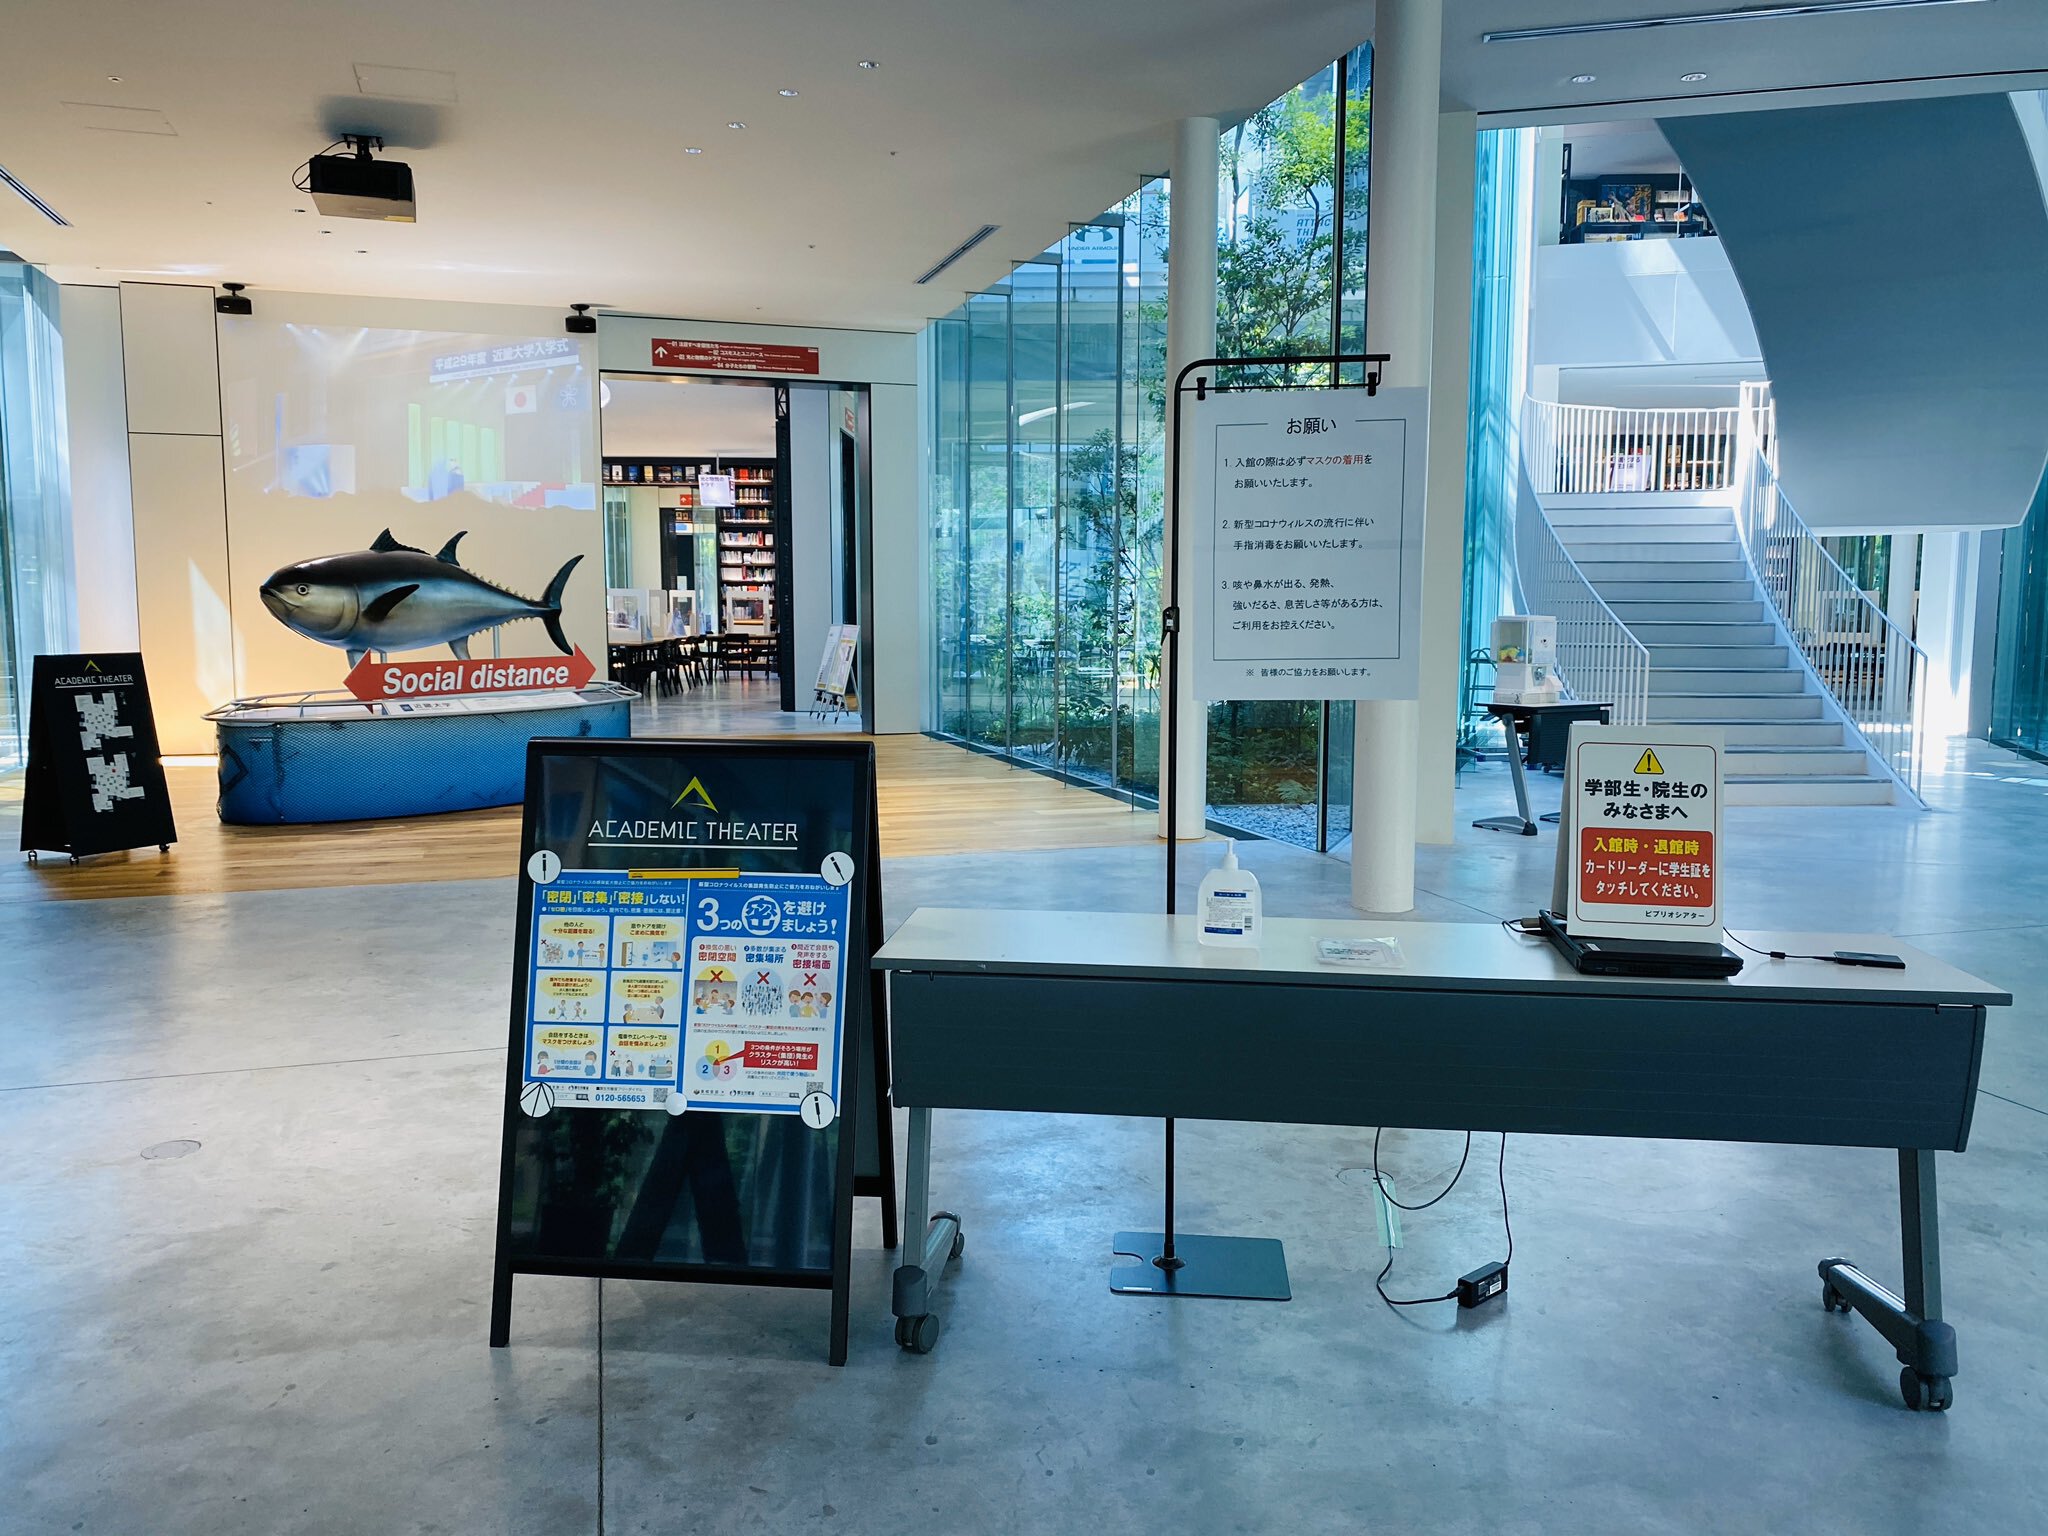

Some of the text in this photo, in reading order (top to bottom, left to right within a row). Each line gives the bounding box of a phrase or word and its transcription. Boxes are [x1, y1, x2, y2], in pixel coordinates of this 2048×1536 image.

[1286, 417, 1336, 434] お願い
[1235, 454, 1372, 468] 入館の際は必ずマスクの着用を
[1234, 478, 1313, 488] お願いいたします。
[1234, 517, 1374, 530] 新型コロナウィルスの流行に伴い
[1234, 538, 1364, 550] 手指消毒をお願いいたします。
[1232, 578, 1334, 590] 咳や鼻水が出る、発熱、
[1232, 598, 1384, 610] 強いだるさ、息苦しさ等がある方は、
[1232, 620, 1335, 630] ご利用をお控えください。
[1261, 668, 1371, 677] 皆様のご協力をお願いします。
[54, 674, 134, 685] ACADEMIC THEATER
[382, 664, 569, 694] Social distance
[1584, 778, 1708, 799] 学部生・院生の
[1604, 802, 1688, 820] みなさまへ
[588, 820, 798, 841] ACADEMIC THEATER
[1594, 837, 1700, 856] 入館時・退館時
[1586, 859, 1710, 878] カードリーダーに学生証を
[1596, 881, 1699, 899] タッチしてください。
[542, 890, 686, 905] 「密閉」「密集」「密接」しない！
[783, 900, 826, 916] を避け
[782, 919, 837, 935] ましょう！
[698, 952, 737, 962] 密閉空間
[746, 953, 784, 964] 密集場所
[792, 959, 831, 970] 密接場面
[715, 1045, 720, 1054] 1
[702, 1065, 708, 1074] 2
[724, 1066, 730, 1075] 3
[596, 1094, 646, 1102] 0120-565653
